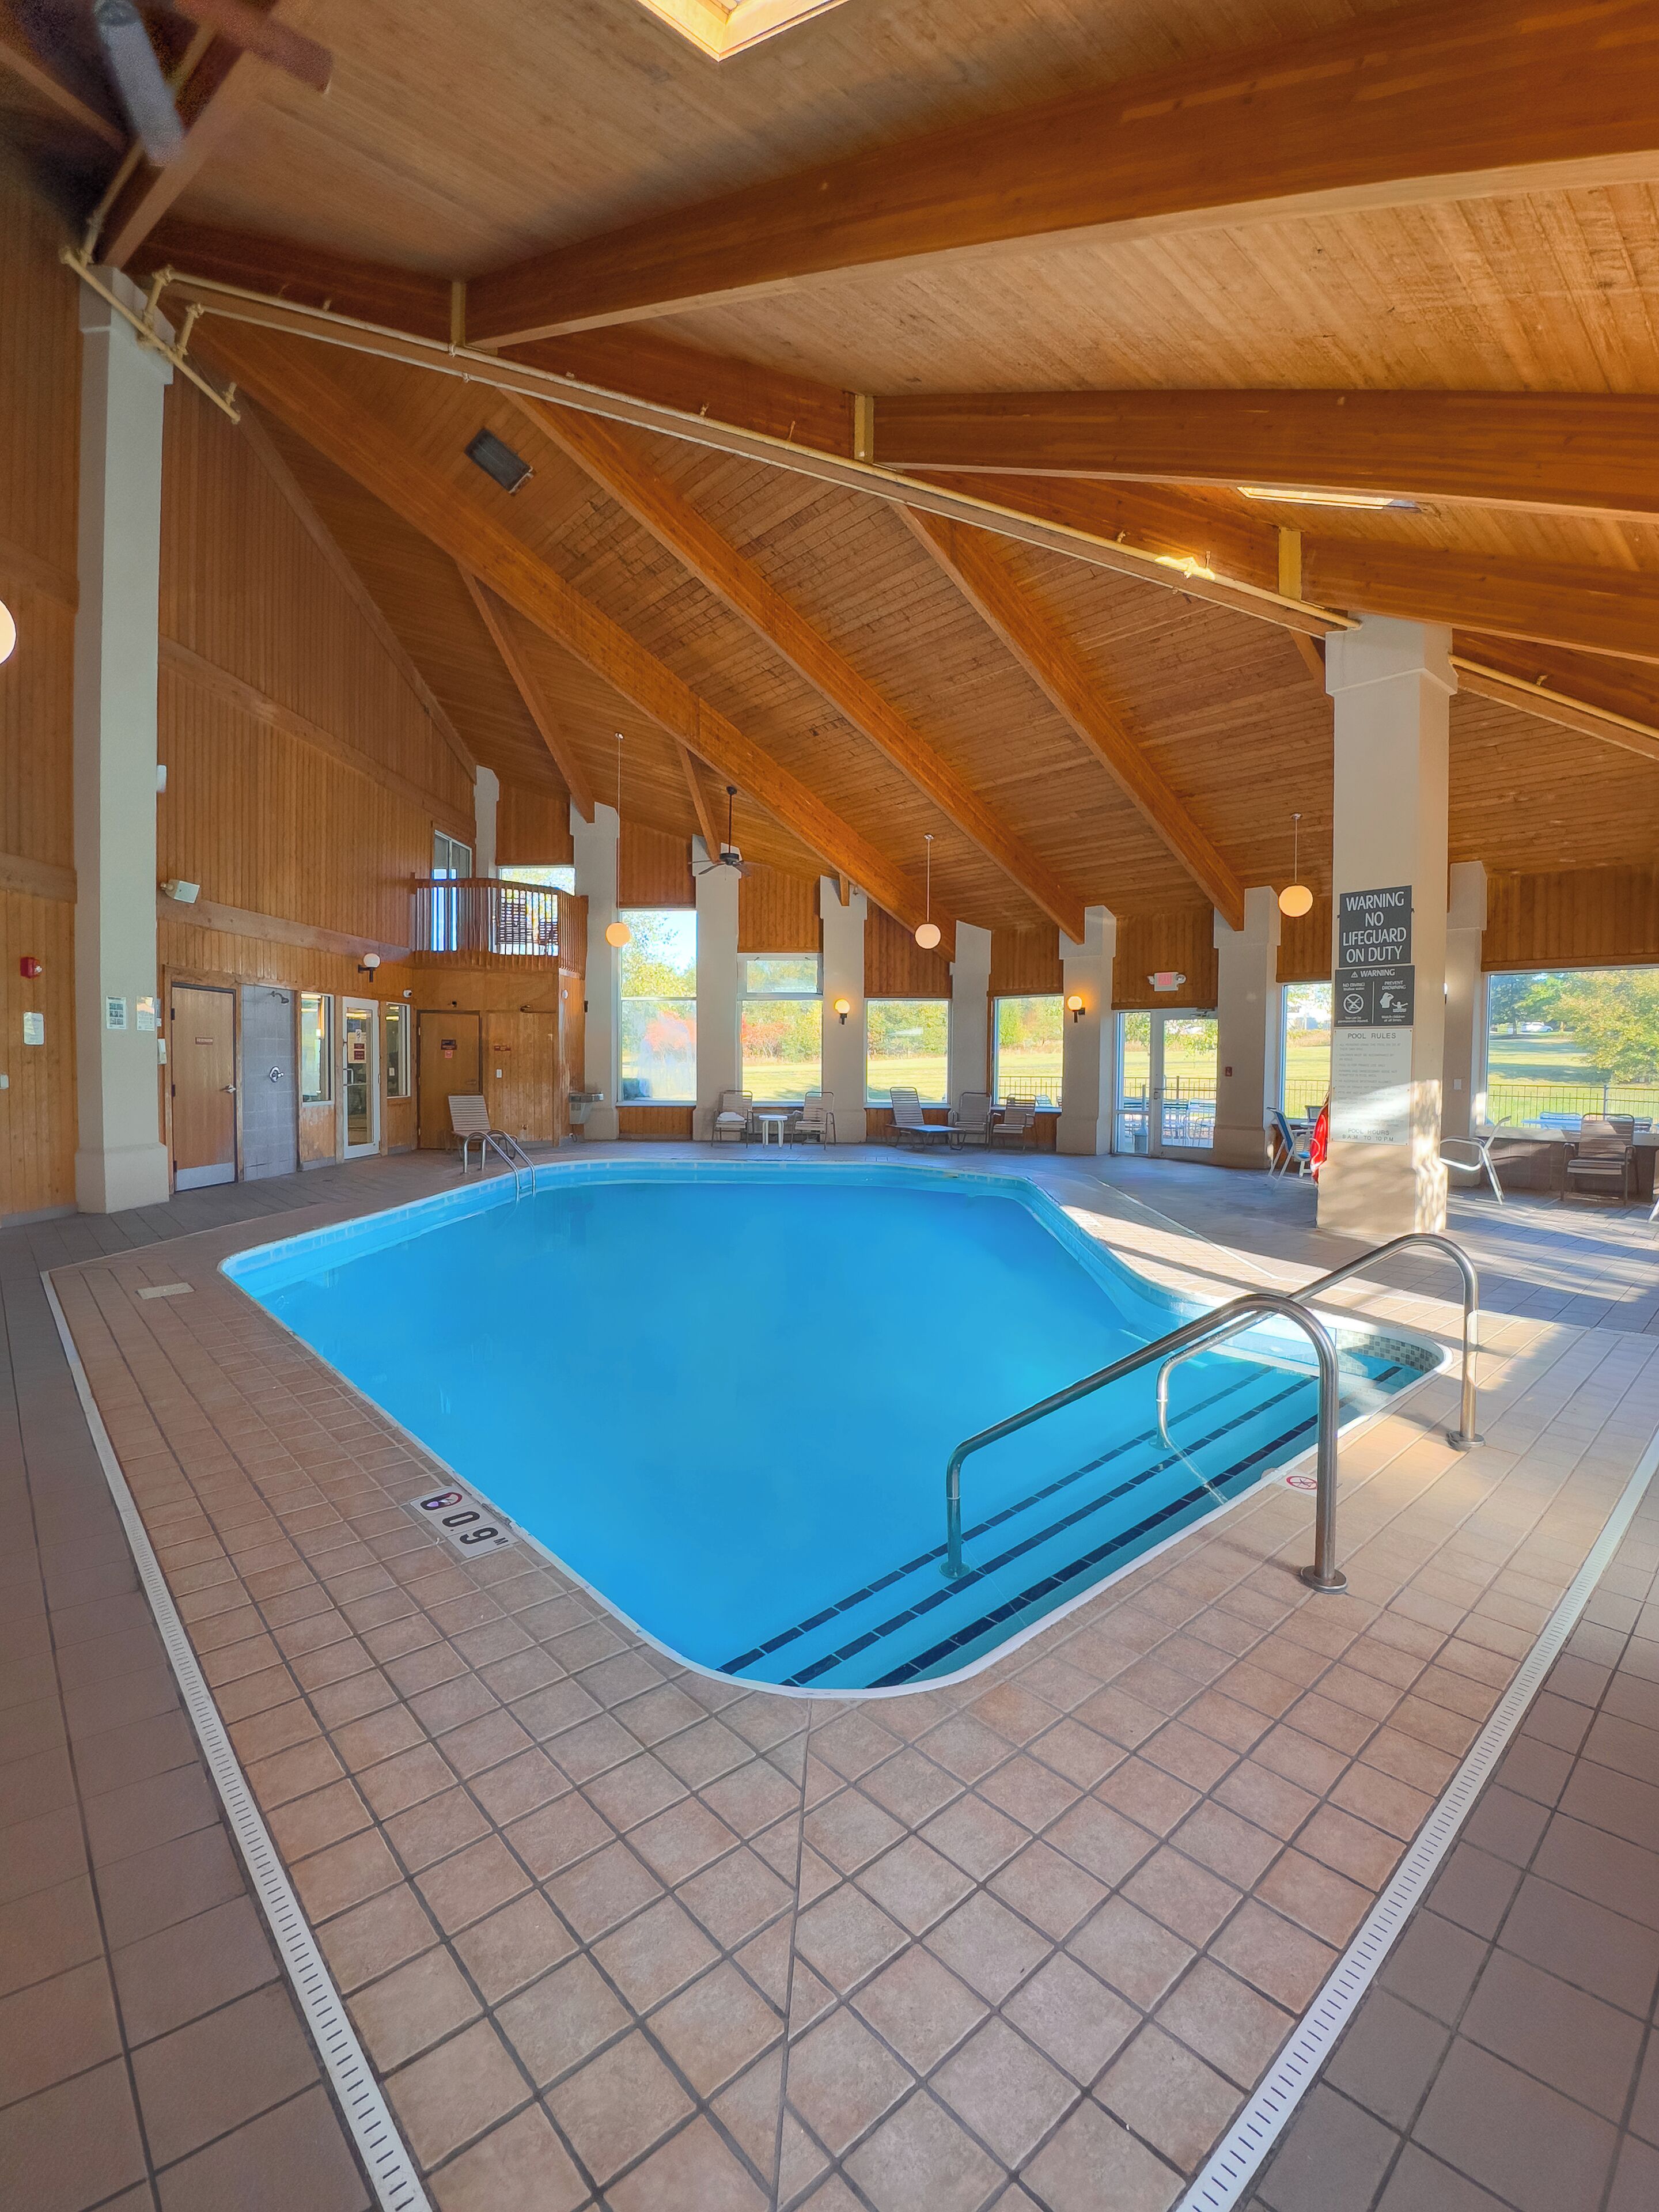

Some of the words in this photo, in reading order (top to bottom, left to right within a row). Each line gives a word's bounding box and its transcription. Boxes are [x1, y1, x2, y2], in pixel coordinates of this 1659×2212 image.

[1346, 891, 1404, 911] WARNING
[1365, 911, 1384, 927] NO
[1343, 927, 1407, 946] LIFEGUARD
[1346, 948, 1365, 963] ON
[1368, 945, 1403, 962] DUTY
[1360, 969, 1395, 978] WARNING
